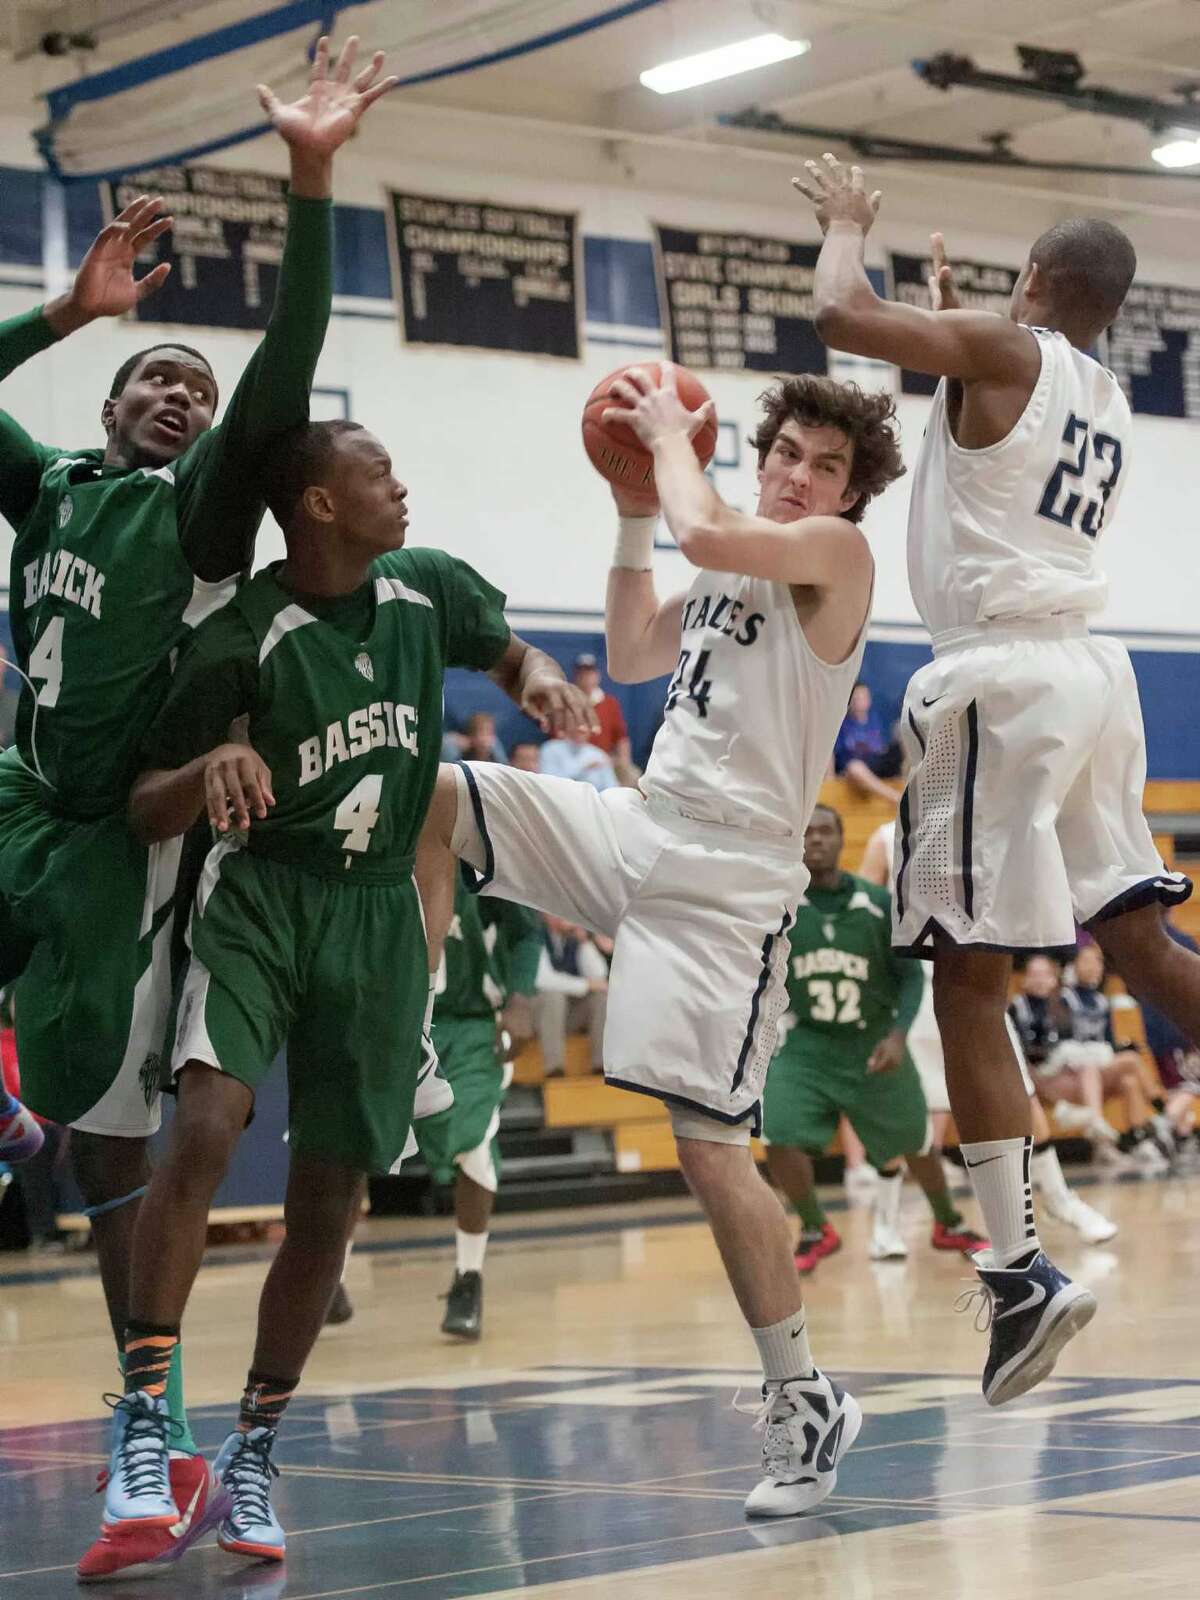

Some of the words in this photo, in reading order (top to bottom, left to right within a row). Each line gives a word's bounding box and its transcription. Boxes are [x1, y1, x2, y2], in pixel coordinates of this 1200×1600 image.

[1038, 413, 1122, 538] 23
[298, 701, 419, 787] BASSIC
[333, 774, 384, 853] 4
[808, 980, 861, 1023] 32
